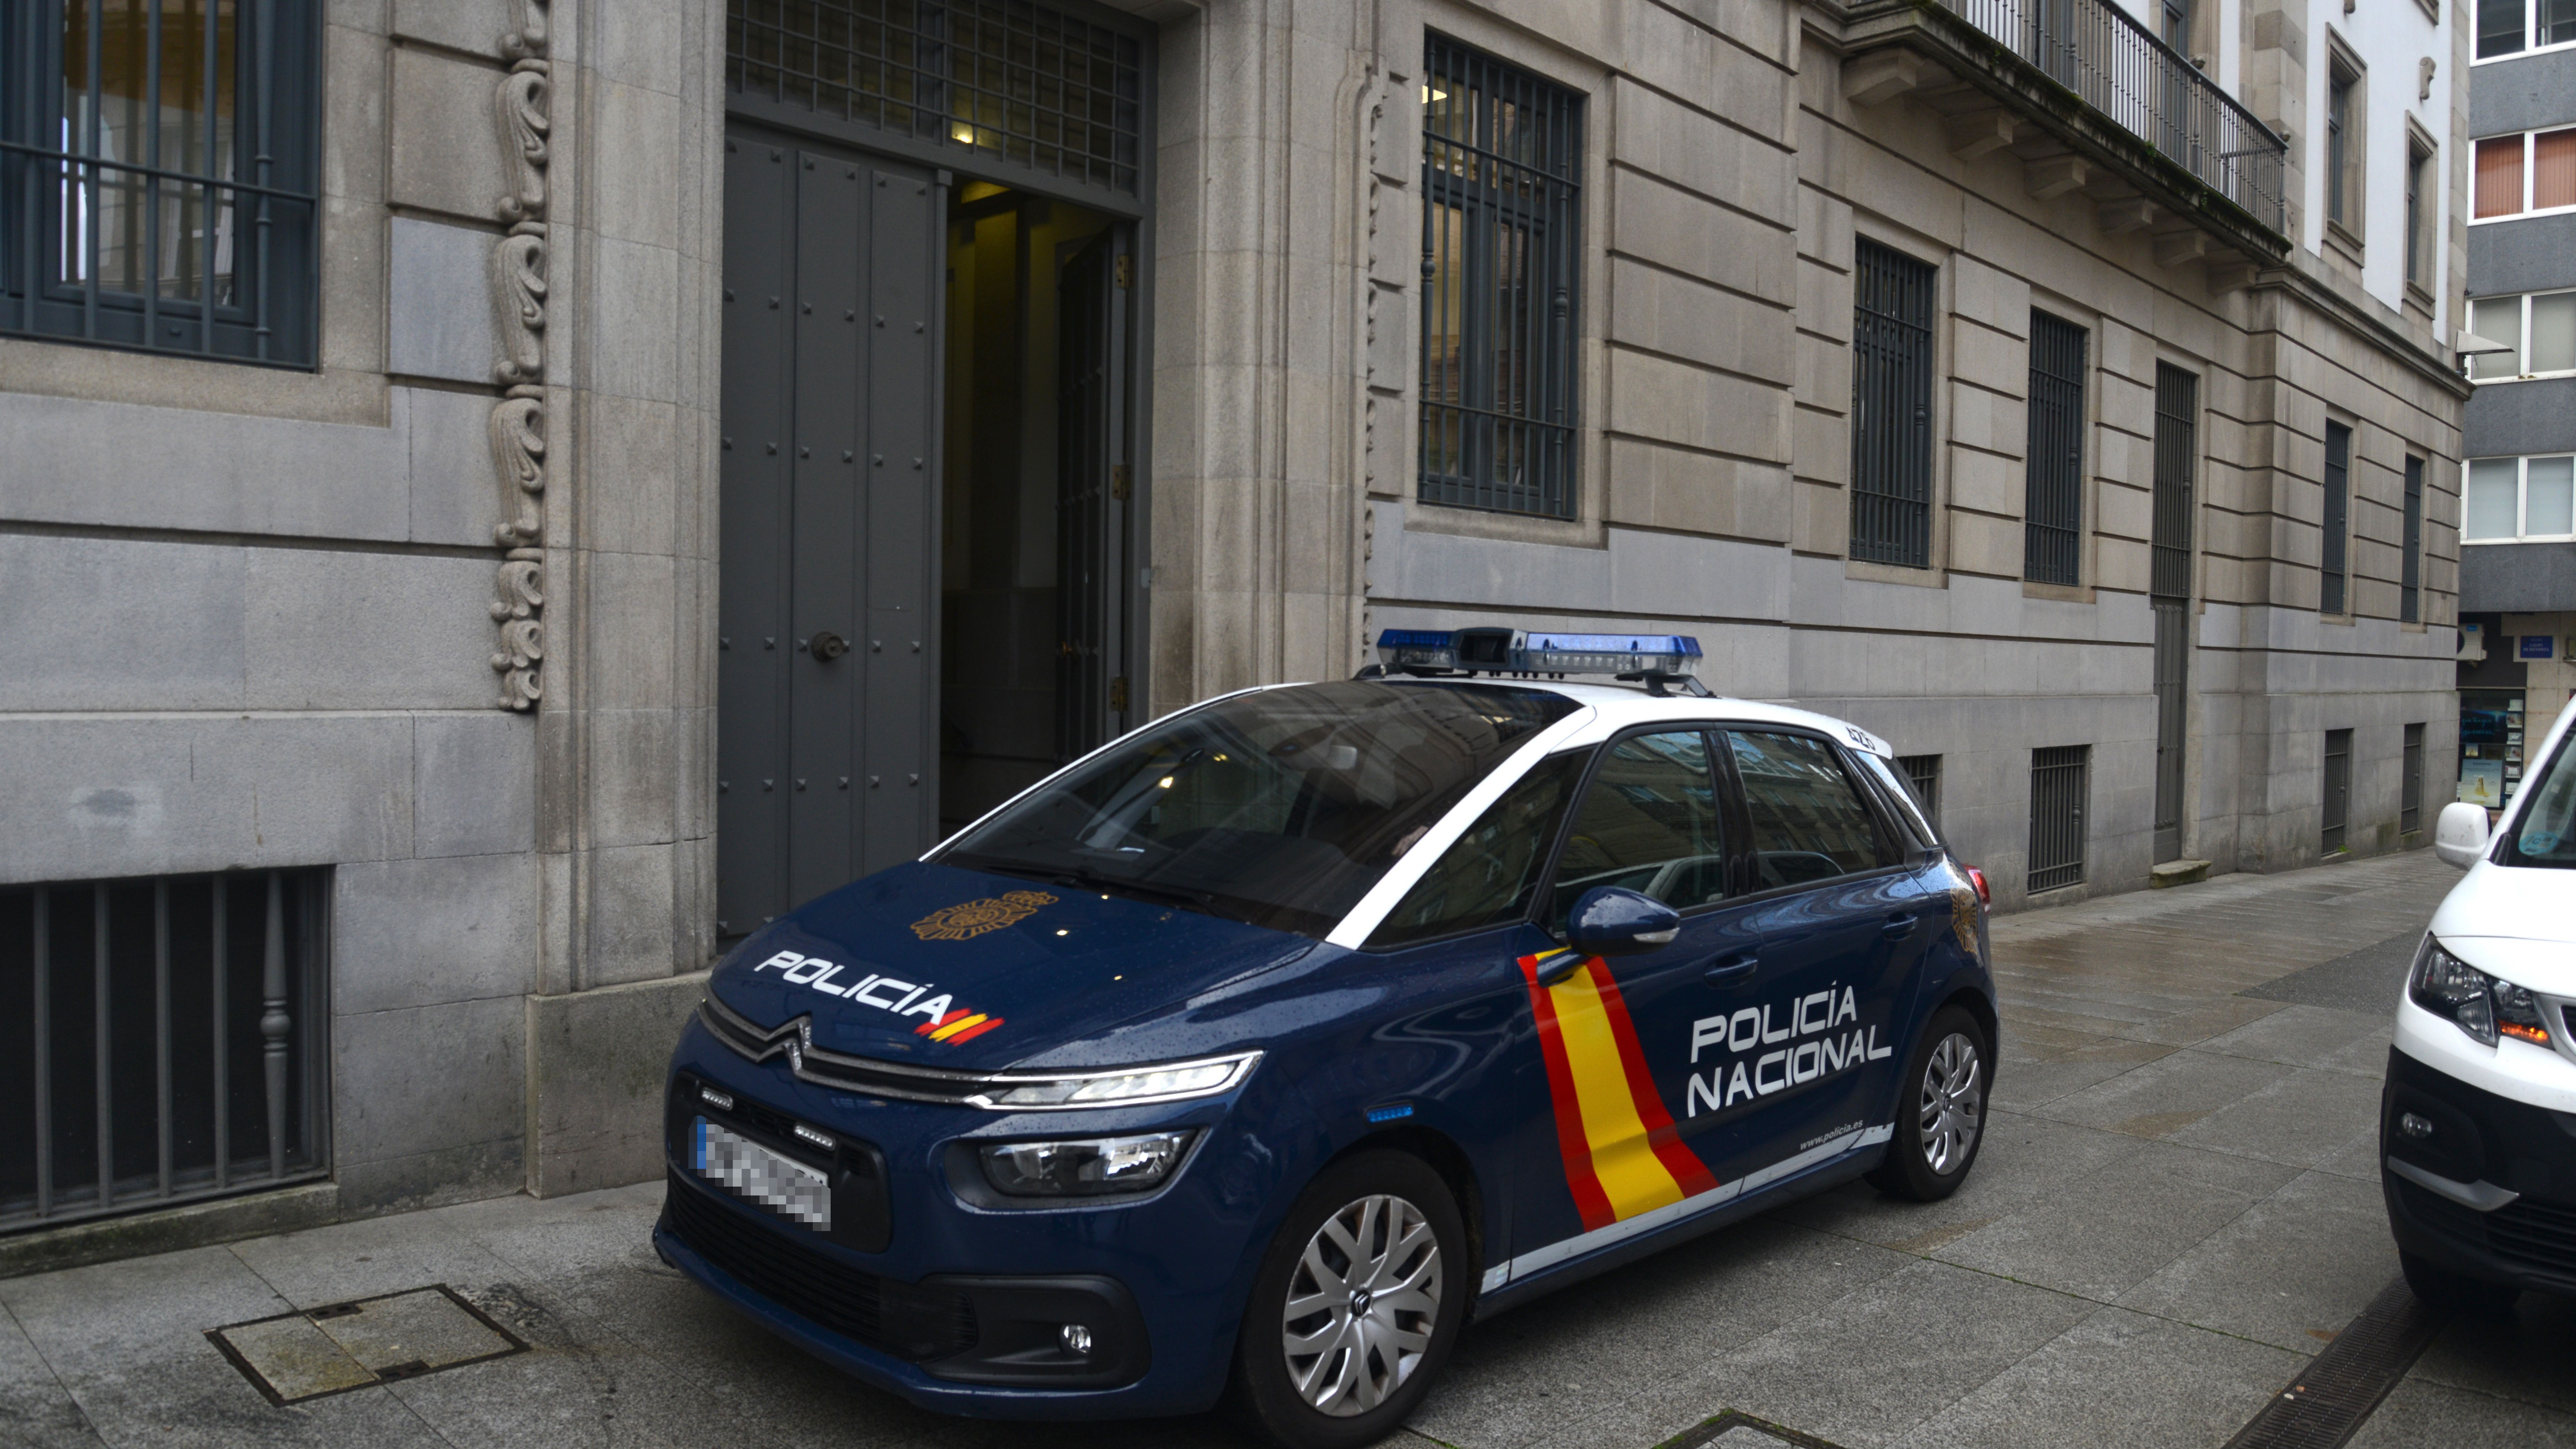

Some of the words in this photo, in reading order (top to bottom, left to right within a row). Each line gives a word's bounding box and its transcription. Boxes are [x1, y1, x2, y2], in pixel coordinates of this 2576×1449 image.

[754, 950, 953, 1026] POLICÍA
[1690, 980, 1857, 1064] POLICÍA
[1687, 1024, 1892, 1118] NACIONAL
[1800, 1119, 1863, 1150] www.policia.es
